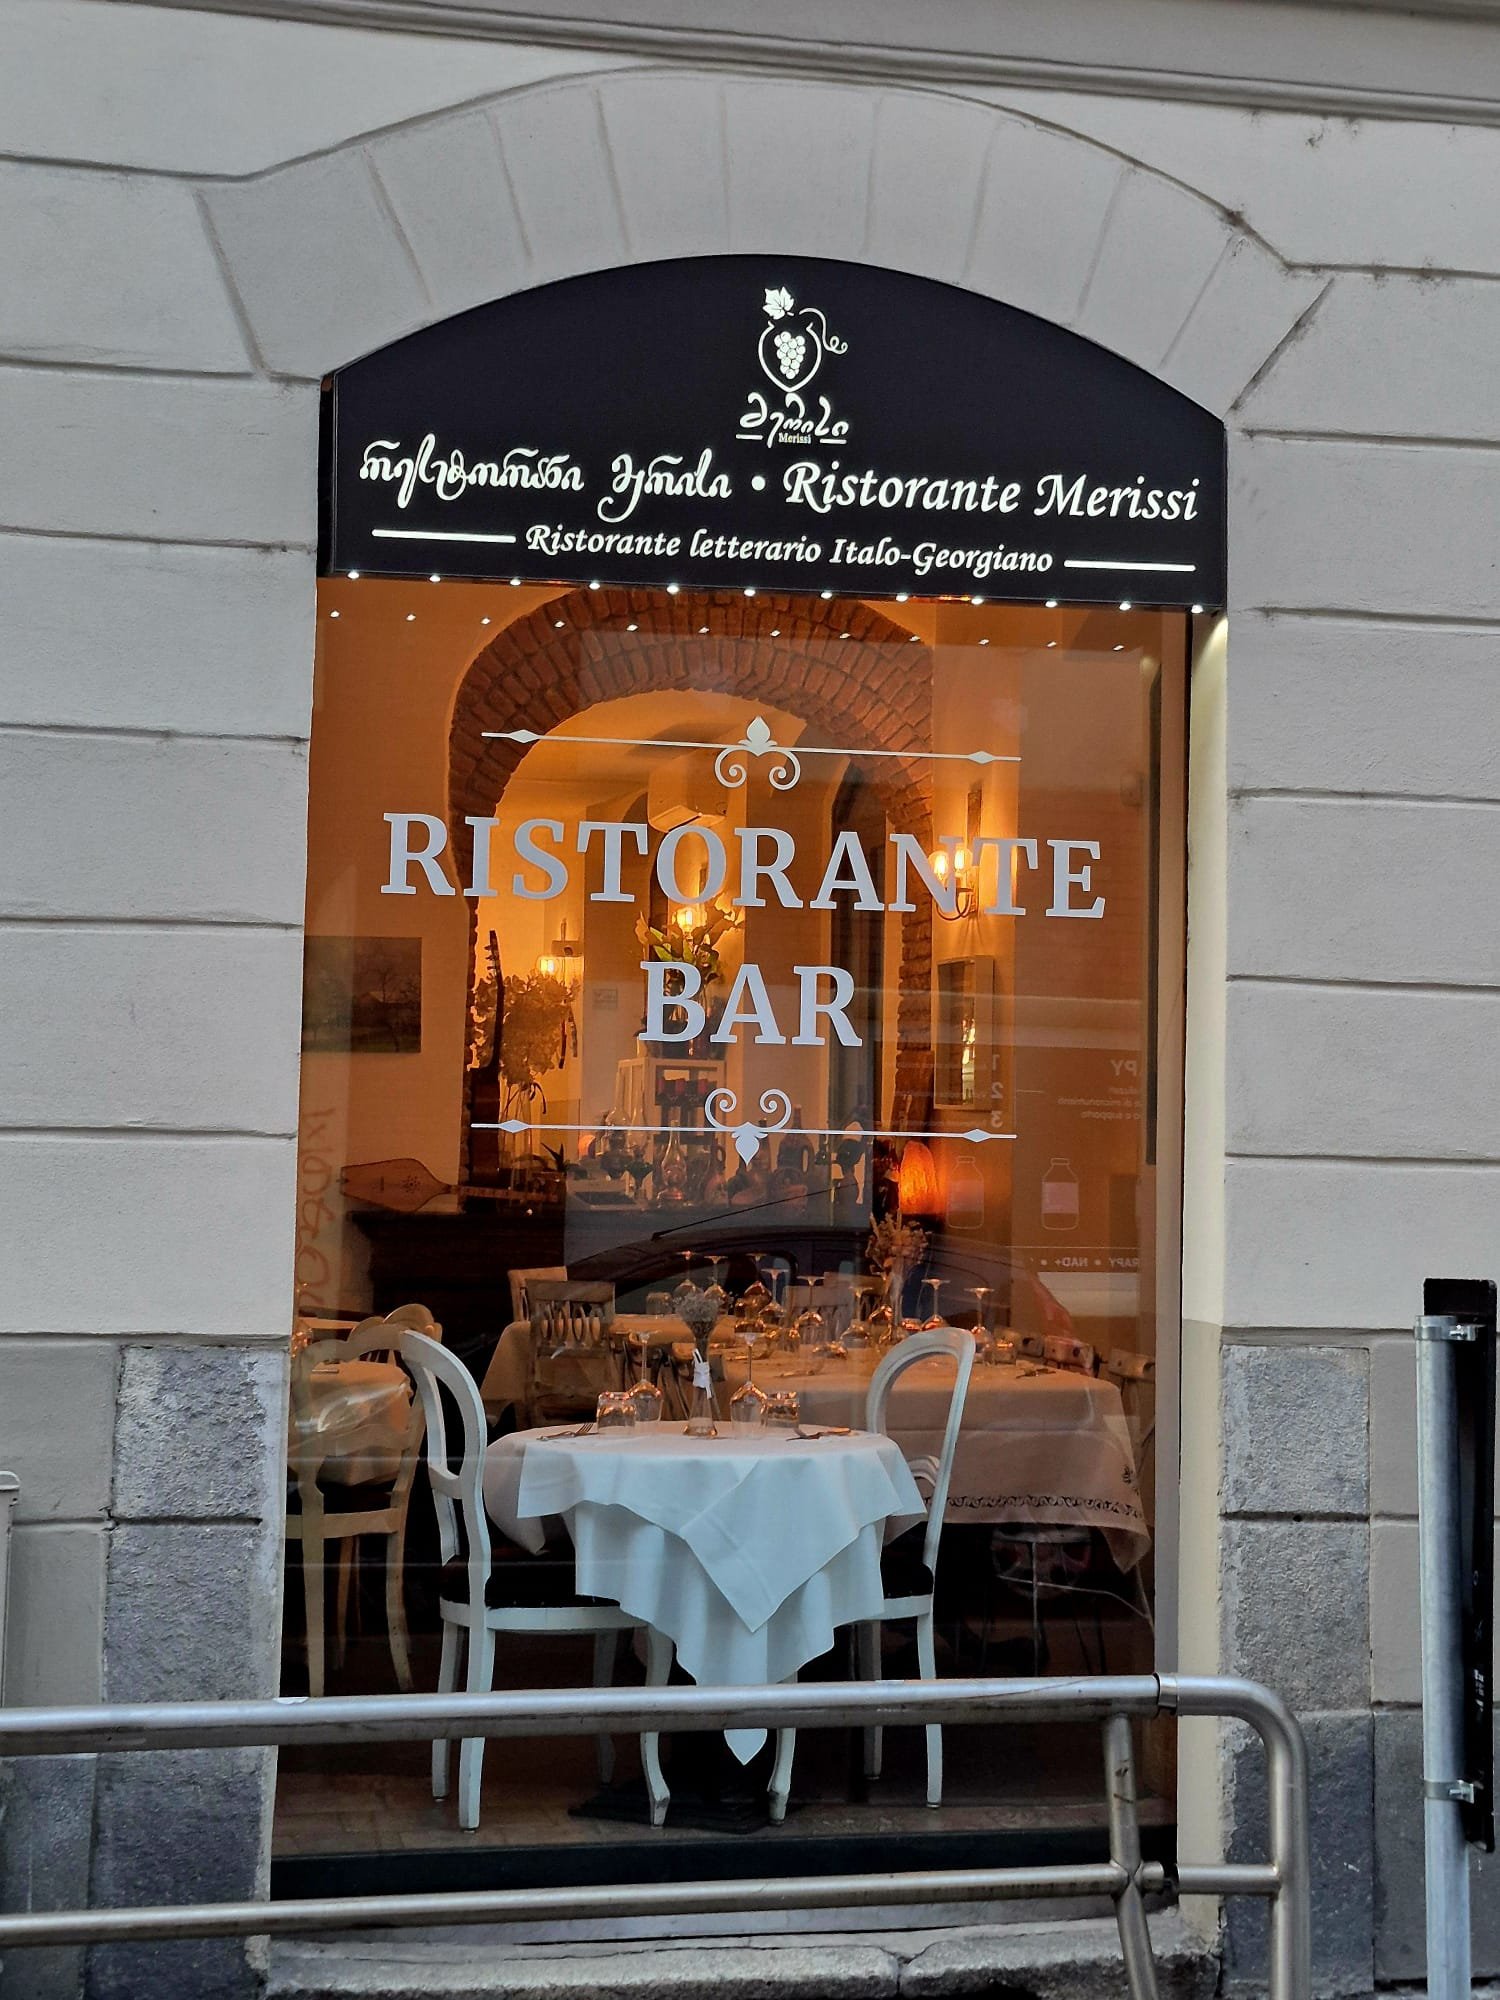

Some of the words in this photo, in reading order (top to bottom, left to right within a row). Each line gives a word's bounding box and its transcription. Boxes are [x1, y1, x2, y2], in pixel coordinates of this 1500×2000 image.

[778, 431, 813, 445] Merissi
[782, 460, 1023, 514] Ristorante
[1033, 473, 1200, 523] Merissi
[525, 524, 683, 558] Ristorante
[689, 528, 823, 564] letterario
[828, 538, 1055, 580] Italo-Georgiano
[380, 811, 1107, 919] RISTORANTE
[638, 960, 863, 1047] BAR
